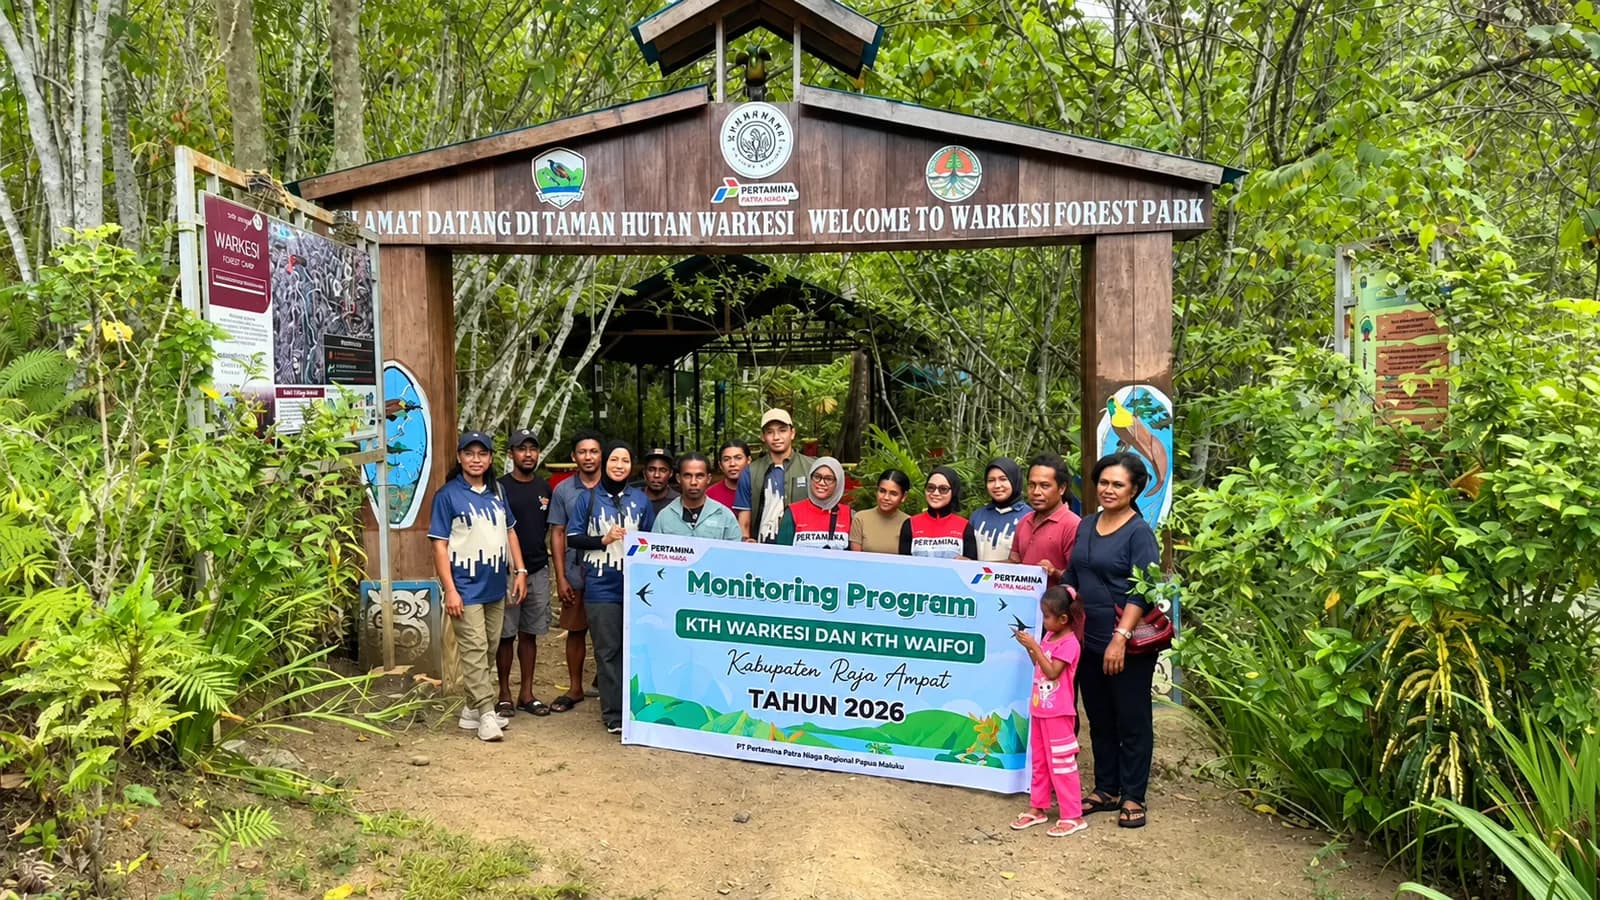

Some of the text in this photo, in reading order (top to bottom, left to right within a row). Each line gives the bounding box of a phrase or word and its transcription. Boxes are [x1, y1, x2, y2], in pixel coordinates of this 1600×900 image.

[741, 185, 794, 194] PERTAMINA
[427, 210, 511, 236] DATANG
[516, 210, 542, 236] DI
[543, 210, 616, 237] TAMAN
[621, 211, 692, 238] HUTAN
[698, 210, 795, 237] WARKESI
[808, 198, 1204, 234] WELCOME TO WARKESI FOREST PARK
[213, 230, 260, 260] WARKESI
[651, 544, 695, 555] PERTAMINA
[796, 532, 844, 542] PERTAMNA
[913, 538, 960, 547] PERTAMINA
[994, 573, 1043, 584] PERTAMINA
[687, 569, 976, 618] Monitoring Program
[685, 616, 975, 655] KTH WARKESI DAN KTH WAIFOI
[727, 648, 952, 695] Kabupaten Raja Ampat
[748, 688, 905, 722] TAHUN 2026
[736, 742, 905, 770] PT Pertamina Patra Niaga Regional Papua Maluku
